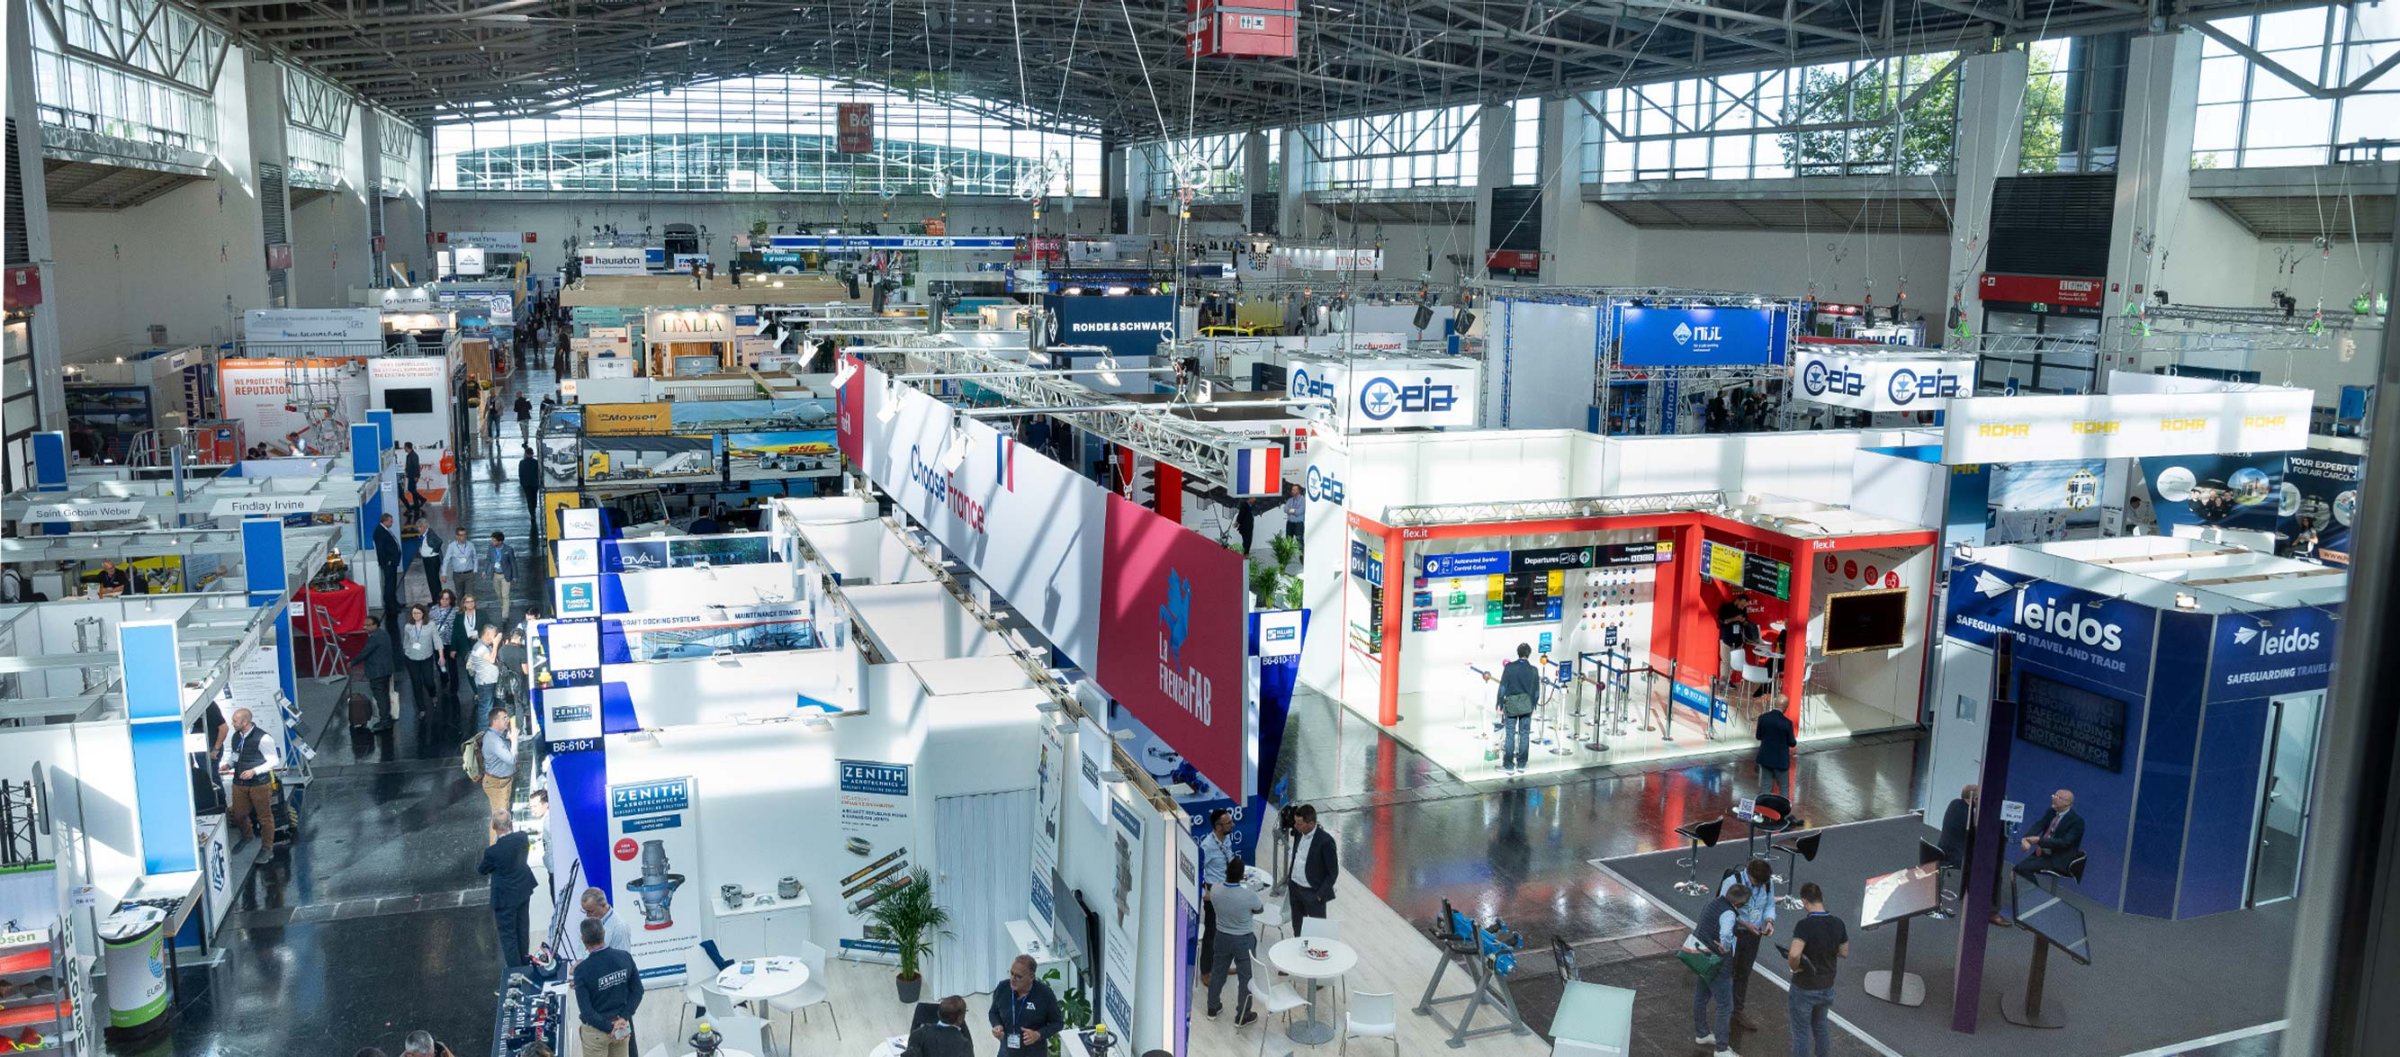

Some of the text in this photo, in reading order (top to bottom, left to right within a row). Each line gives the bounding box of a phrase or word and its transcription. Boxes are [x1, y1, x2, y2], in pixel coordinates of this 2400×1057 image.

[850, 113, 870, 128] B6
[902, 239, 939, 247] ELAFLEX
[595, 255, 640, 265] hauraton
[661, 318, 723, 333] ITALIA
[1073, 321, 1173, 332] ROHDE&SCHWARZ
[246, 377, 273, 385] PROTECT
[234, 385, 292, 396] REPUTATION
[2071, 420, 2121, 434] ROHR
[2160, 418, 2206, 432] ROHR
[2244, 416, 2287, 429] ROHR
[1979, 423, 2030, 437] ROHR
[788, 444, 817, 453] DHL
[2290, 456, 2314, 468] YOUR
[2292, 466, 2308, 475] FOR
[2309, 468, 2322, 476] AIR
[911, 444, 985, 535] Choose France
[36, 507, 131, 518] Saint Gobain Weber
[231, 499, 305, 514] Findlay Irvine
[1402, 529, 1429, 538] flex.it
[1813, 540, 1836, 550] flex.it
[611, 552, 661, 565] SOVAL
[1524, 556, 1559, 565] Departures
[1369, 562, 1381, 582] 11
[611, 615, 701, 627] AIRCRAFT DOCKING SYSTEMS
[734, 610, 778, 619] MAINTENANCE
[2014, 586, 2122, 651] leidos
[1159, 631, 1168, 663] La
[2259, 626, 2320, 656] leidos
[2028, 634, 2064, 654] TRAVEL
[2065, 644, 2089, 660] AND
[2090, 653, 2127, 673] TRADE
[557, 670, 595, 680] B6-610-2
[2226, 667, 2297, 685] SAFEGUARDING
[2297, 662, 2327, 676] TRAVEL
[554, 705, 591, 716] ZENITH
[2026, 703, 2113, 741] SAFEGUARDING
[552, 740, 594, 752] B6-610-1
[2025, 724, 2087, 753] PROTECTION
[2088, 746, 2110, 761] FOR
[845, 766, 904, 781] ZENITH
[616, 784, 683, 802] ZENITH
[0, 932, 36, 945] osen
[600, 972, 627, 986] ZENITH
[68, 957, 86, 1052] Rosen
